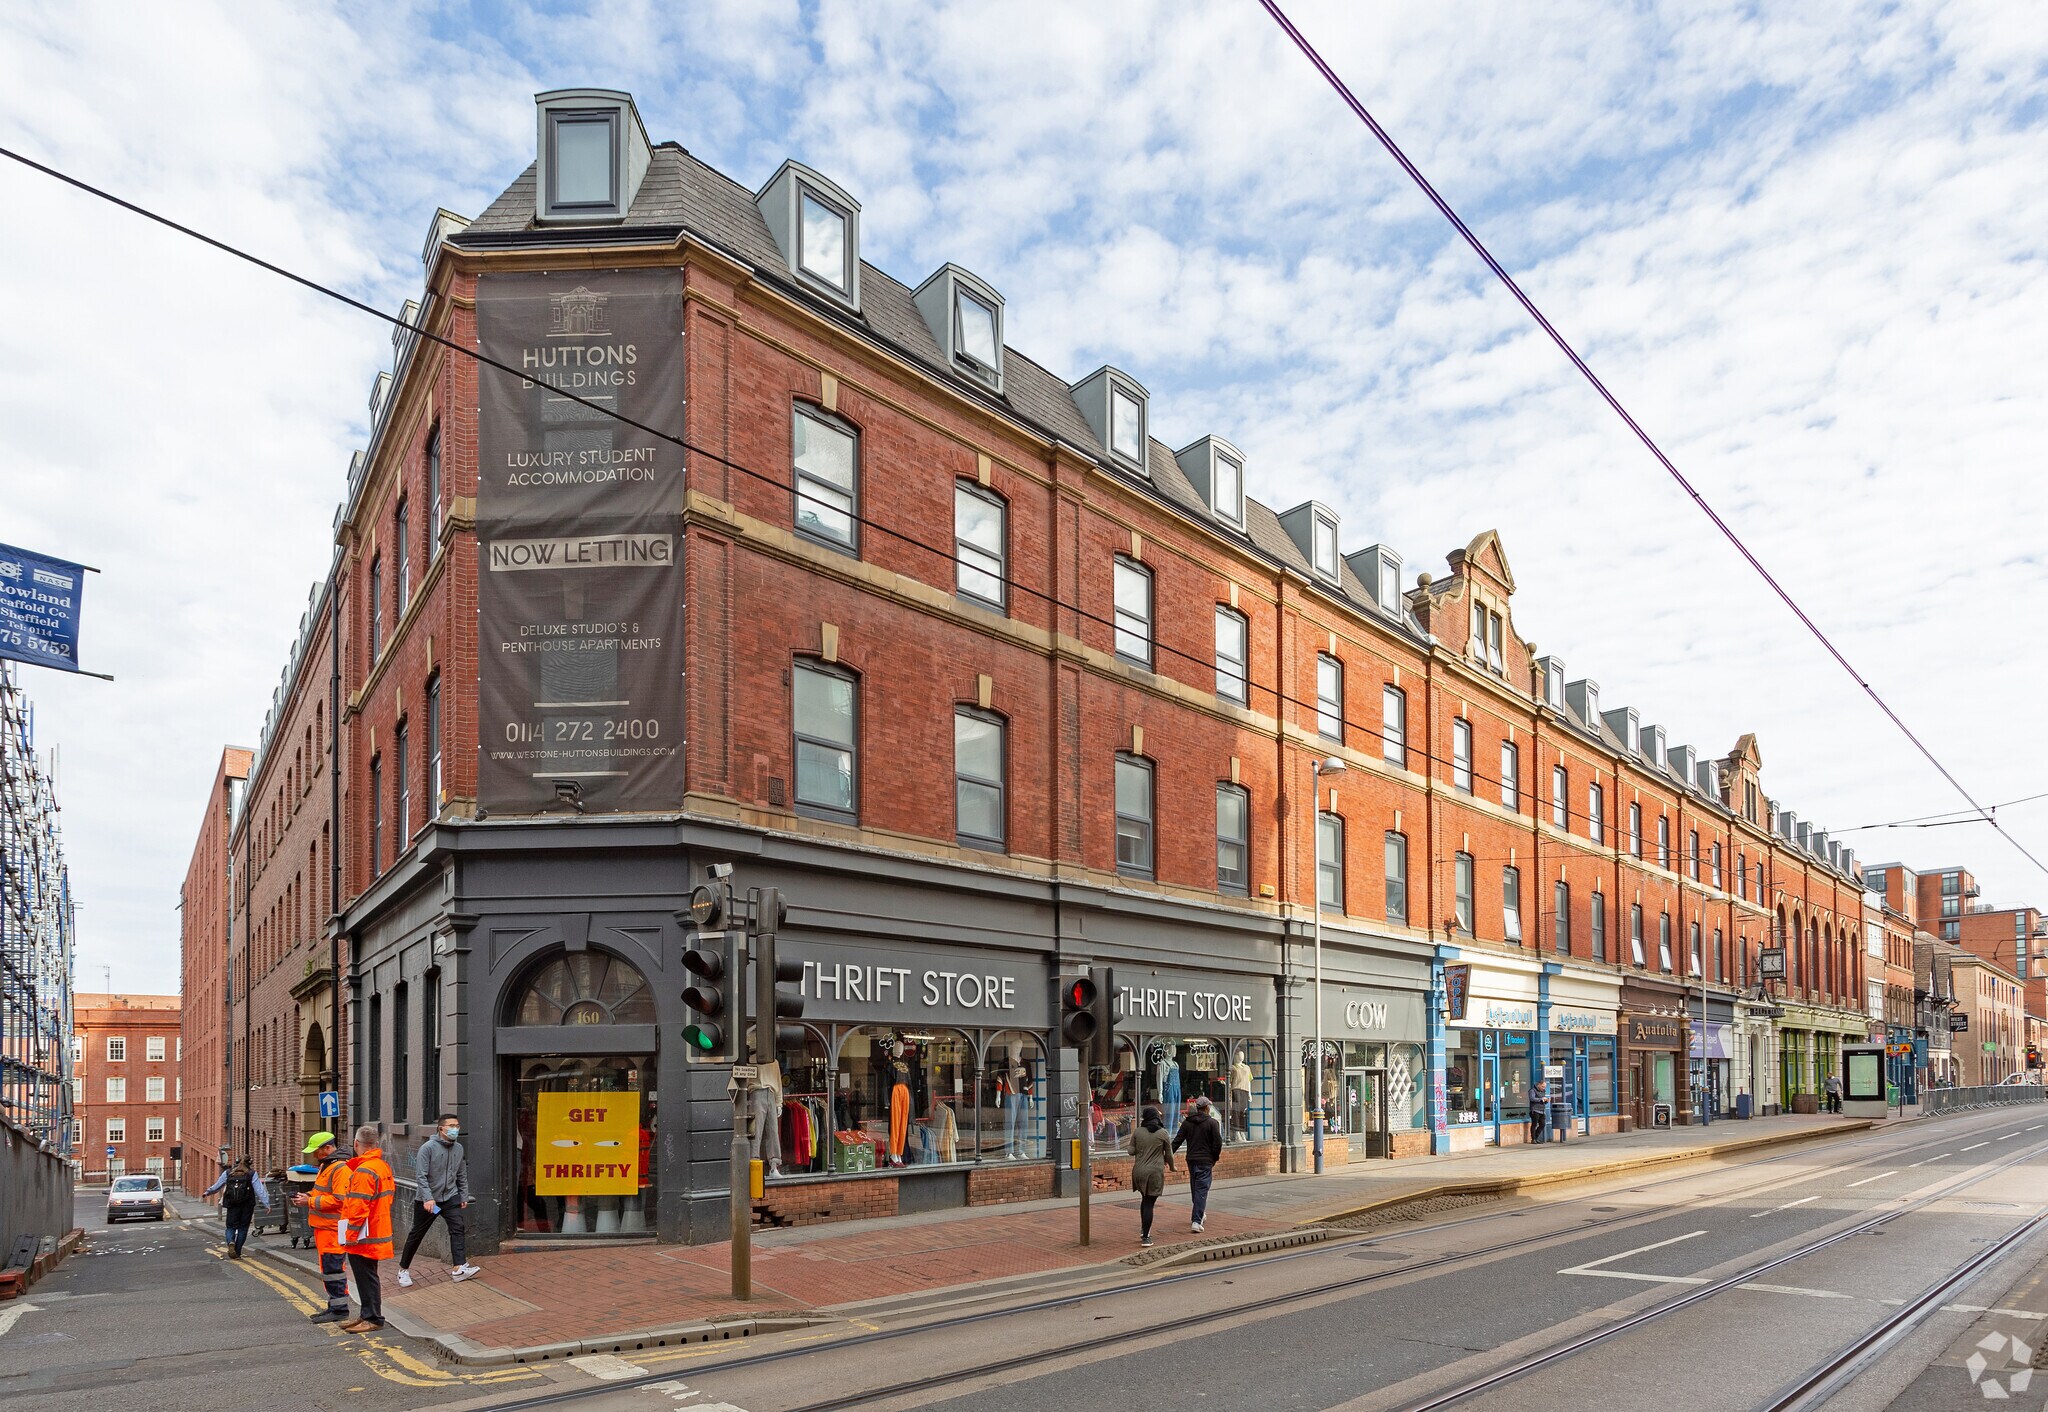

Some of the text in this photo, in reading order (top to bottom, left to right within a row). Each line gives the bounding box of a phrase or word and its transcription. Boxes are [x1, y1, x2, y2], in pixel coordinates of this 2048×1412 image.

[523, 344, 637, 369] HUTTONS
[522, 370, 637, 390] BUILDINGS
[507, 447, 657, 467] LUXURY STUDENT
[507, 468, 655, 486] ACCOMMODATION
[493, 539, 669, 567] NOW LETTING
[39, 575, 67, 587] NASC
[0, 597, 70, 619] caffold Co.
[0, 607, 59, 628] Sheffield
[7, 619, 53, 637] Tel: 0114
[520, 622, 640, 637] DELUXE STUDIO'S &
[0, 629, 71, 657] 75 5752
[502, 638, 661, 653] PENTHOUSE APARTMENTS
[505, 719, 660, 743] 0114 272 2400
[490, 748, 676, 760] WWW.WESTONE-HUTTONSBUILDINGS.COM
[799, 961, 1016, 1010] THRIFT STORE
[1119, 986, 1252, 1022] THRIFT STORE
[1451, 977, 1462, 1017] OPEN
[576, 1010, 600, 1024] 160
[1344, 1000, 1388, 1030] COW
[1634, 1022, 1678, 1041] Anatolia
[568, 1108, 608, 1123] GET
[543, 1164, 632, 1179] THRIFTY
